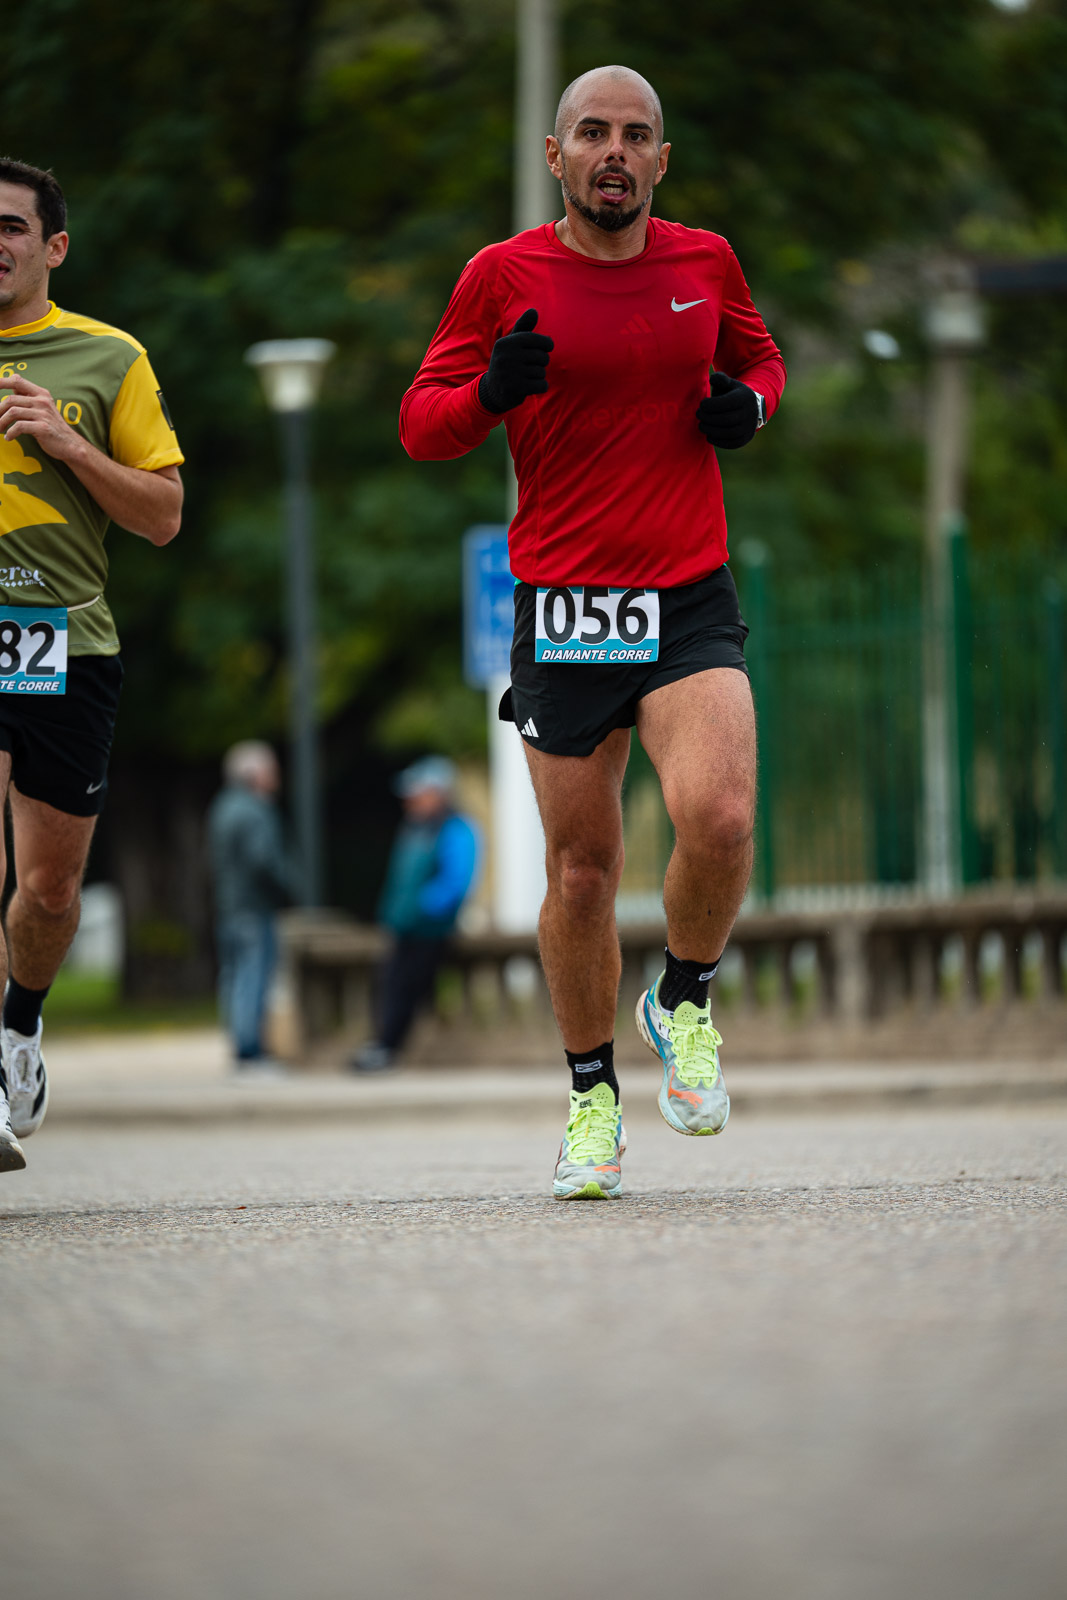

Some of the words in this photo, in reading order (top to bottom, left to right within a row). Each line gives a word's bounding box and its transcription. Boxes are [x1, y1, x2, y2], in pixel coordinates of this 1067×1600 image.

[543, 586, 650, 645] 056
[541, 649, 608, 661] DIAMANTE
[608, 649, 653, 661] CORRE
[17, 681, 60, 692] CORRE
